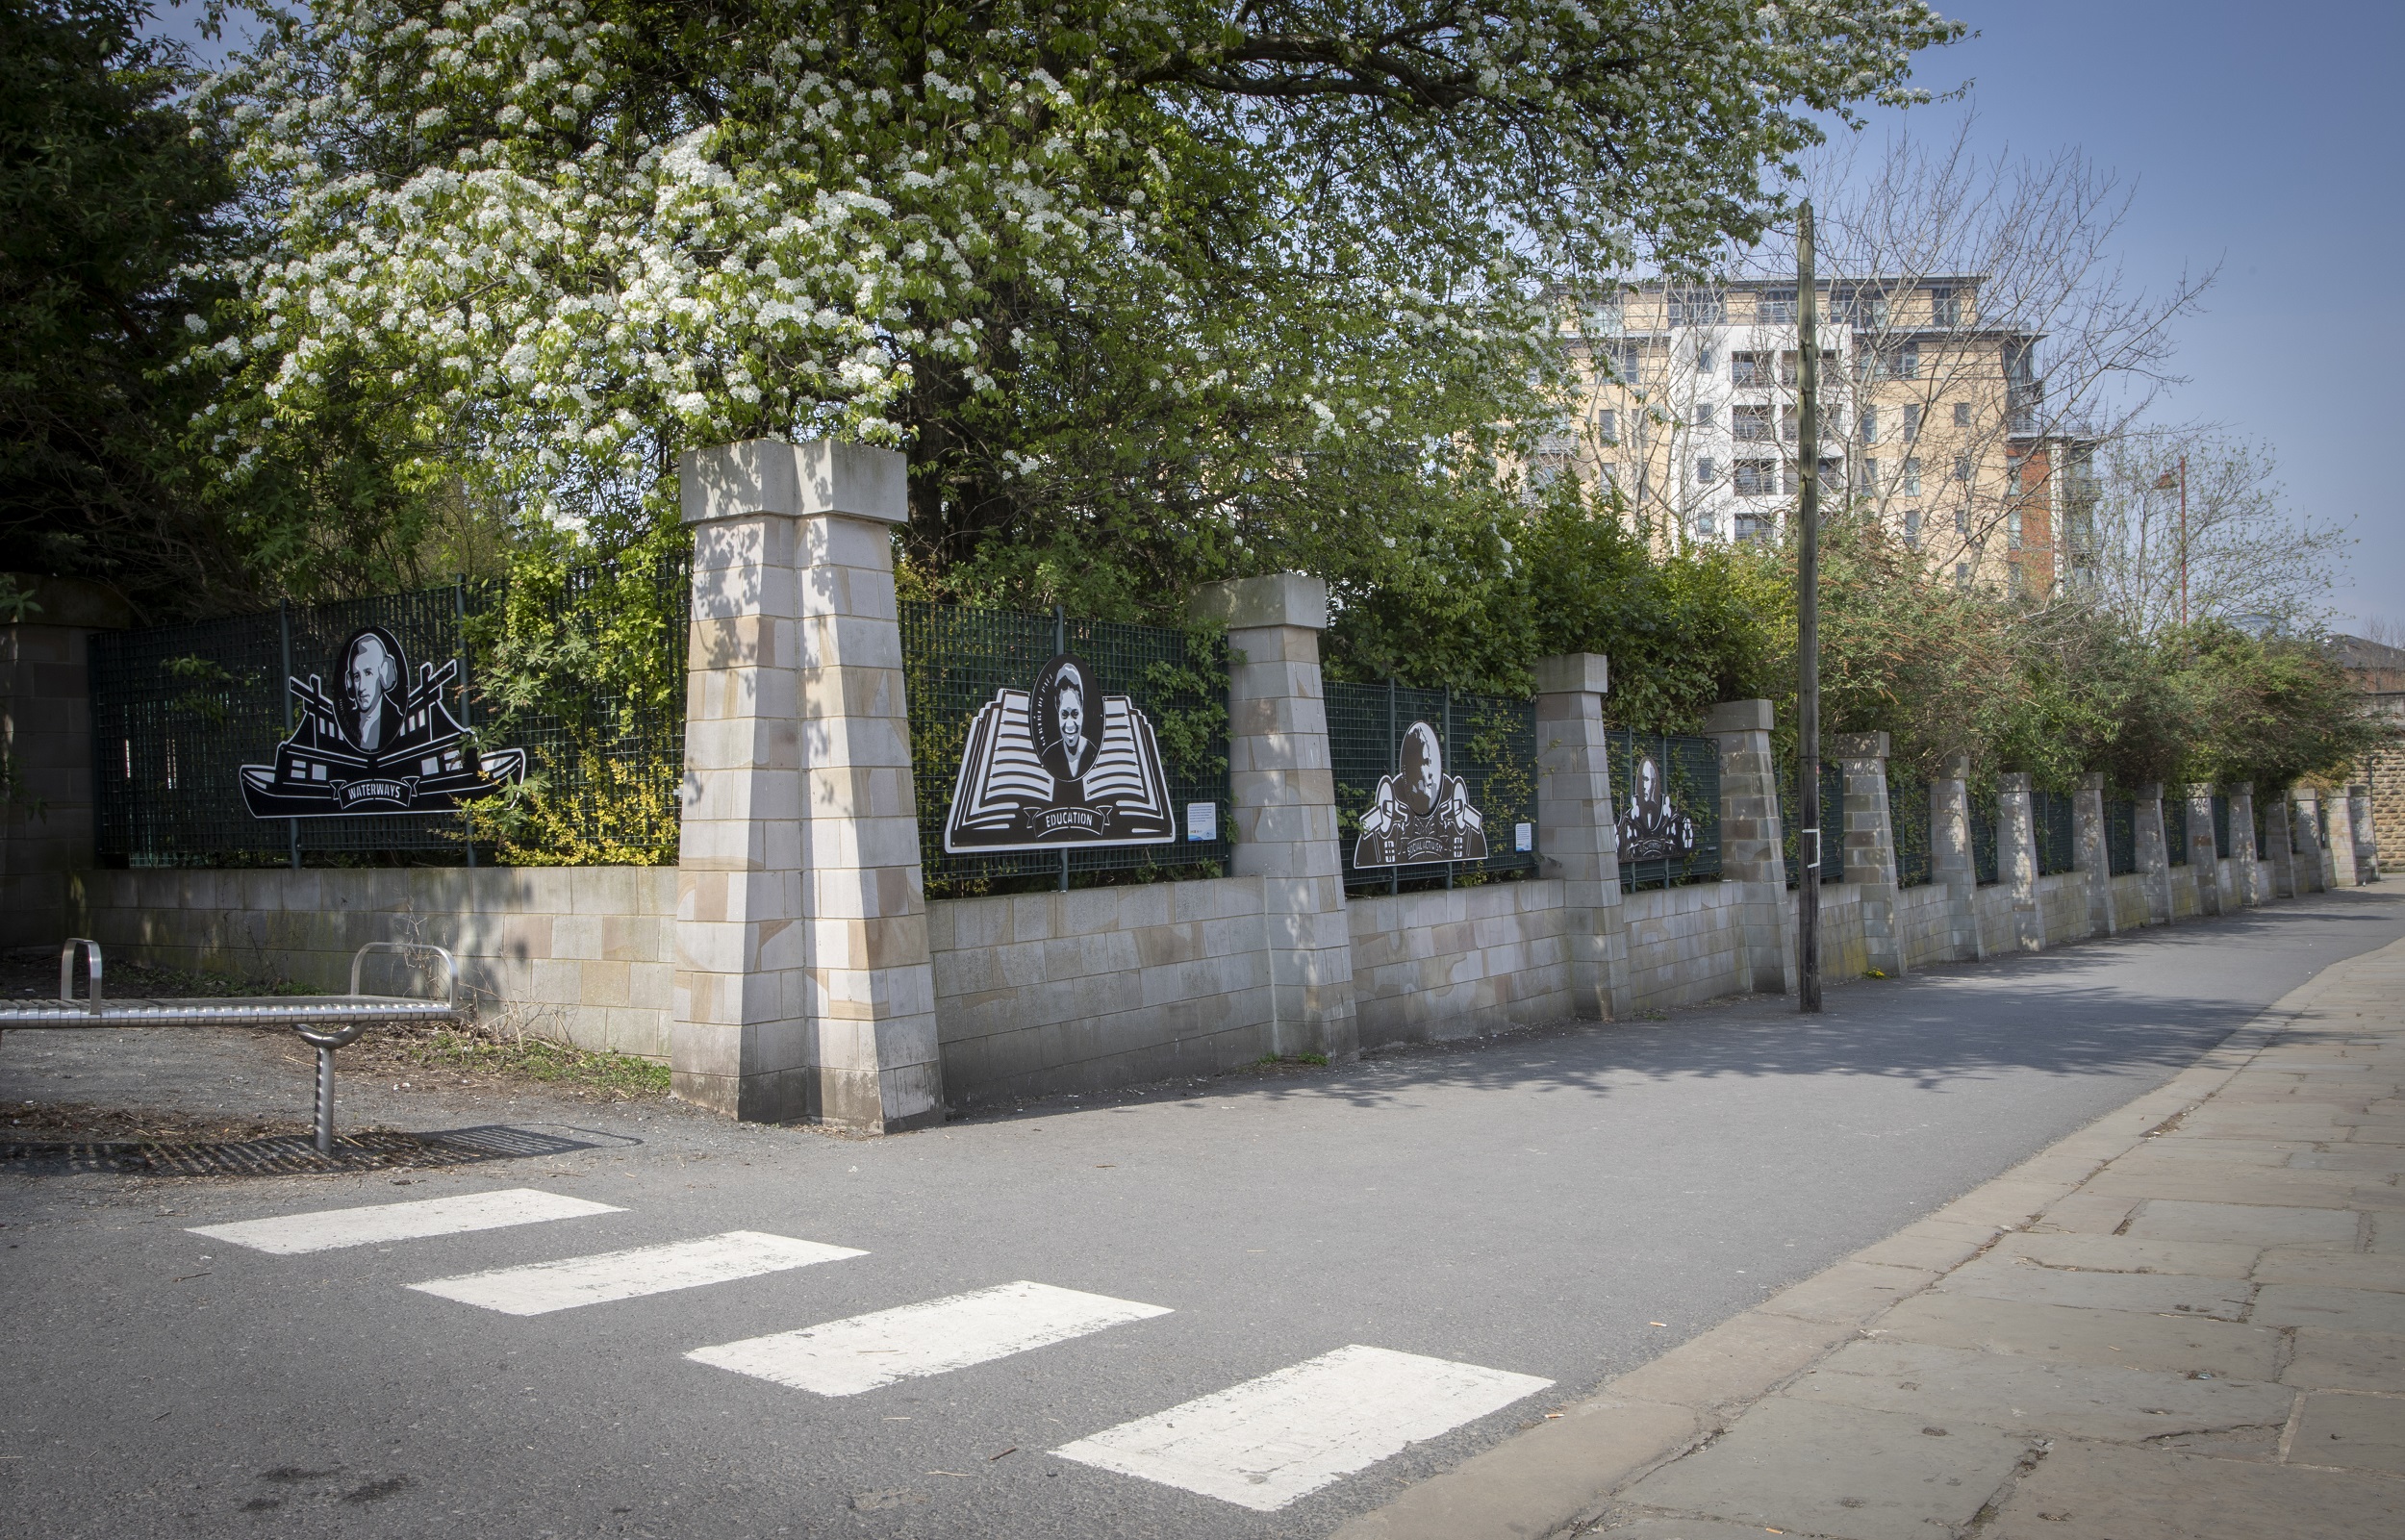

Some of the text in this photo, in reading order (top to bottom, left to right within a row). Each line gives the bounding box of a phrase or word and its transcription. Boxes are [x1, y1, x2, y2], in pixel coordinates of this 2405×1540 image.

[348, 783, 401, 800] WATERWAYS
[1046, 812, 1093, 828] EDUCATION
[1406, 841, 1422, 856] SOCIAL
